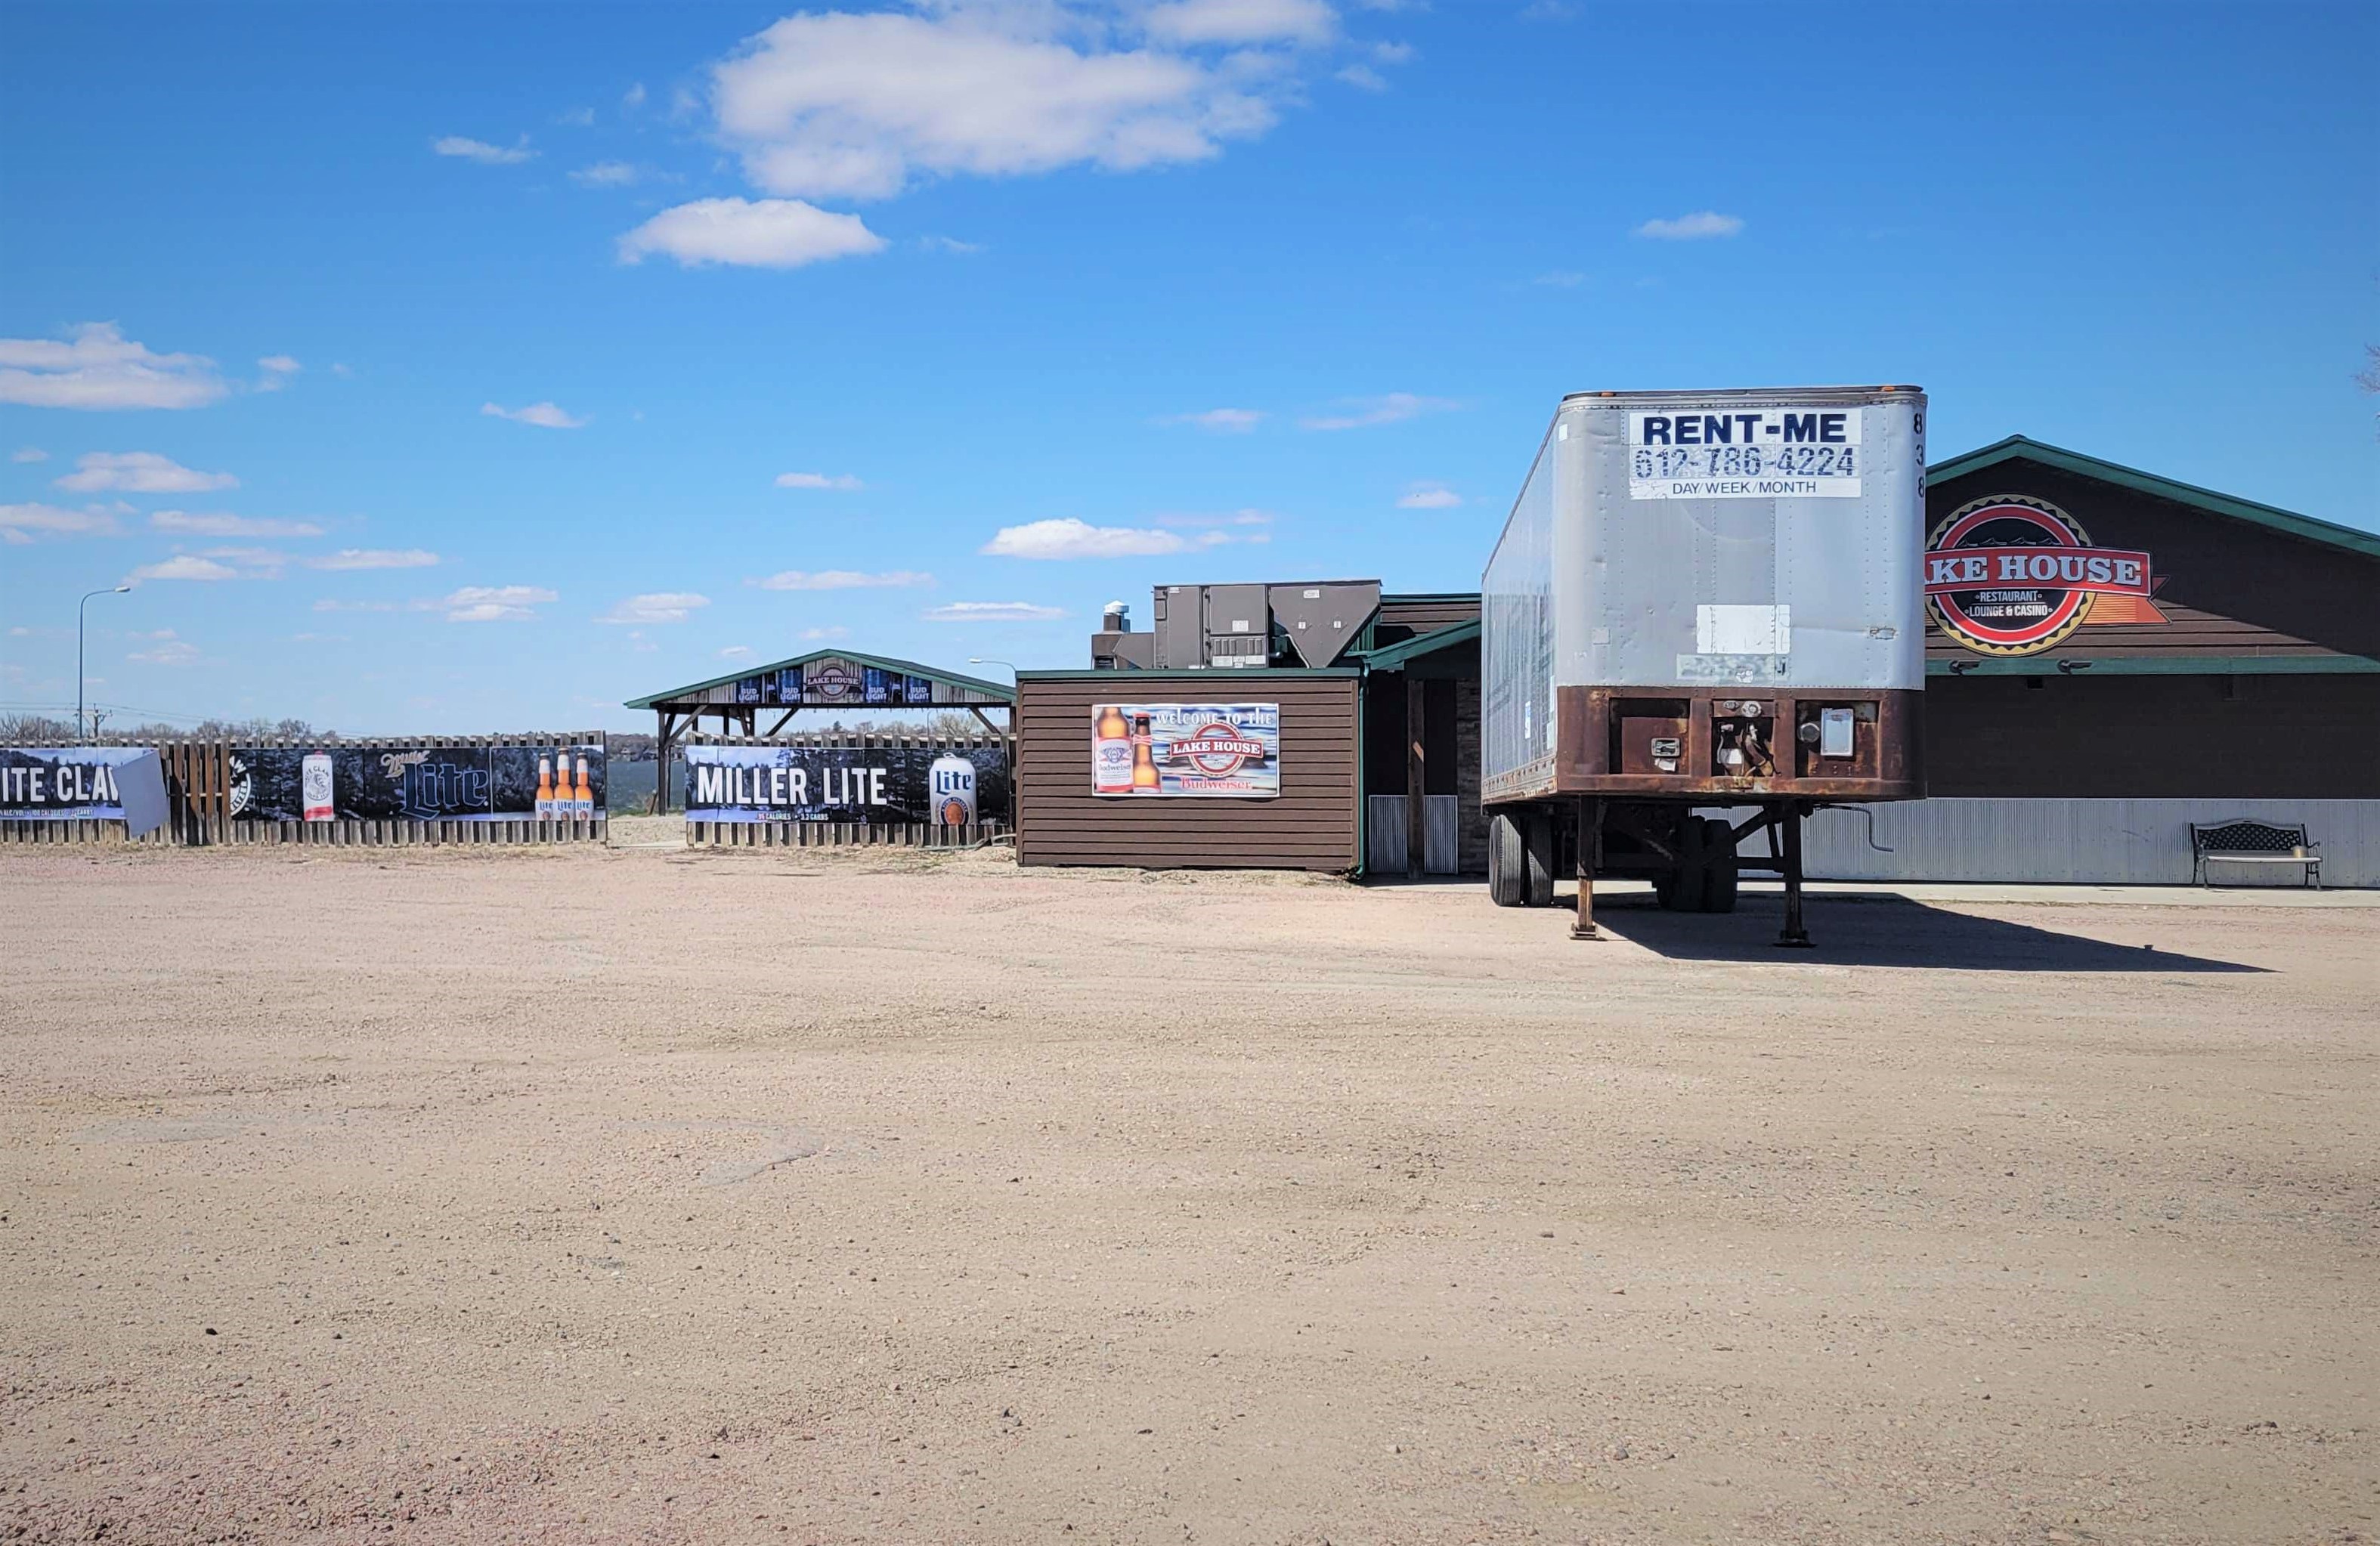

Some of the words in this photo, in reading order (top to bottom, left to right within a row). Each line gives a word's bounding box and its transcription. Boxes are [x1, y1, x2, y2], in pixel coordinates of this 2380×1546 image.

[1644, 413, 1846, 446] RENT-ME
[1636, 447, 1855, 478] 612-786-4224
[1925, 557, 1988, 586] KE
[1998, 555, 2141, 586] HOUSE
[1980, 590, 2038, 602] RESTAURANT
[1969, 605, 2004, 617] LOUNGE
[2005, 605, 2013, 616] &
[2014, 604, 2048, 617] CASINO
[808, 677, 830, 685] LAKE
[1173, 741, 1210, 754] LAKE
[1213, 741, 1261, 754] HOUSE
[2, 767, 45, 802] ITE
[400, 762, 489, 821] Lite
[698, 766, 808, 805] MILLER
[823, 767, 887, 805] LITE
[936, 770, 971, 796] Lite
[1181, 777, 1252, 790] Budweiser
[766, 812, 791, 821] CALORIES
